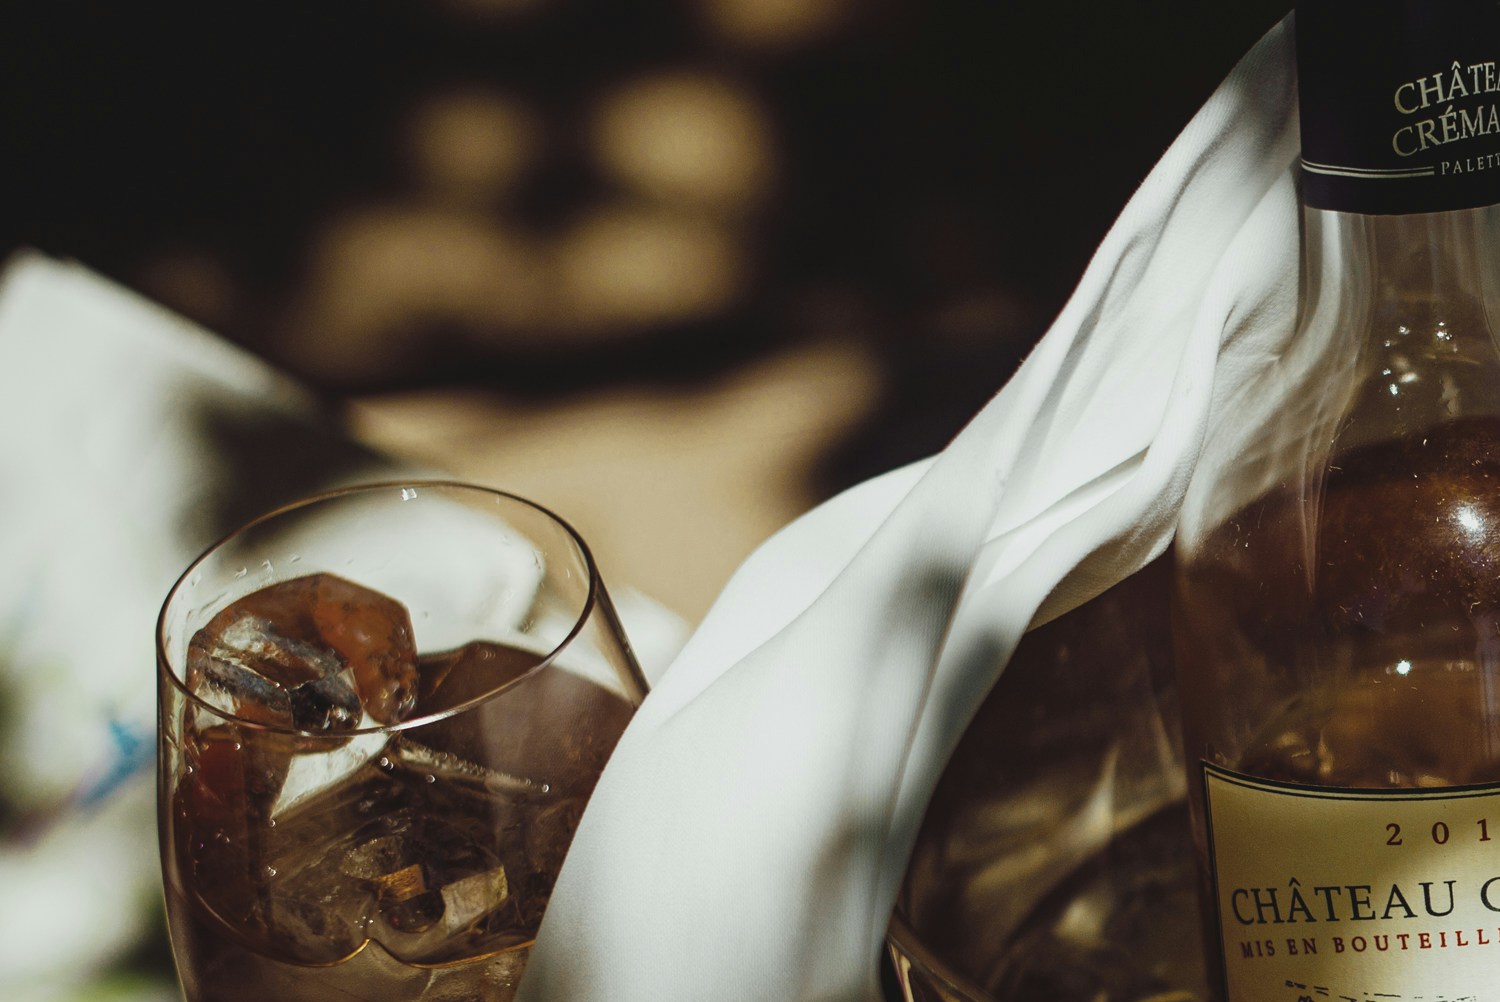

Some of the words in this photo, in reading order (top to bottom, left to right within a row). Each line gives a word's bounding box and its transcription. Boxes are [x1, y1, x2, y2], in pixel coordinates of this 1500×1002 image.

[1231, 876, 1457, 926] CHÂTEAU
[1241, 940, 1276, 959] MIS
[1286, 937, 1318, 956] EN
